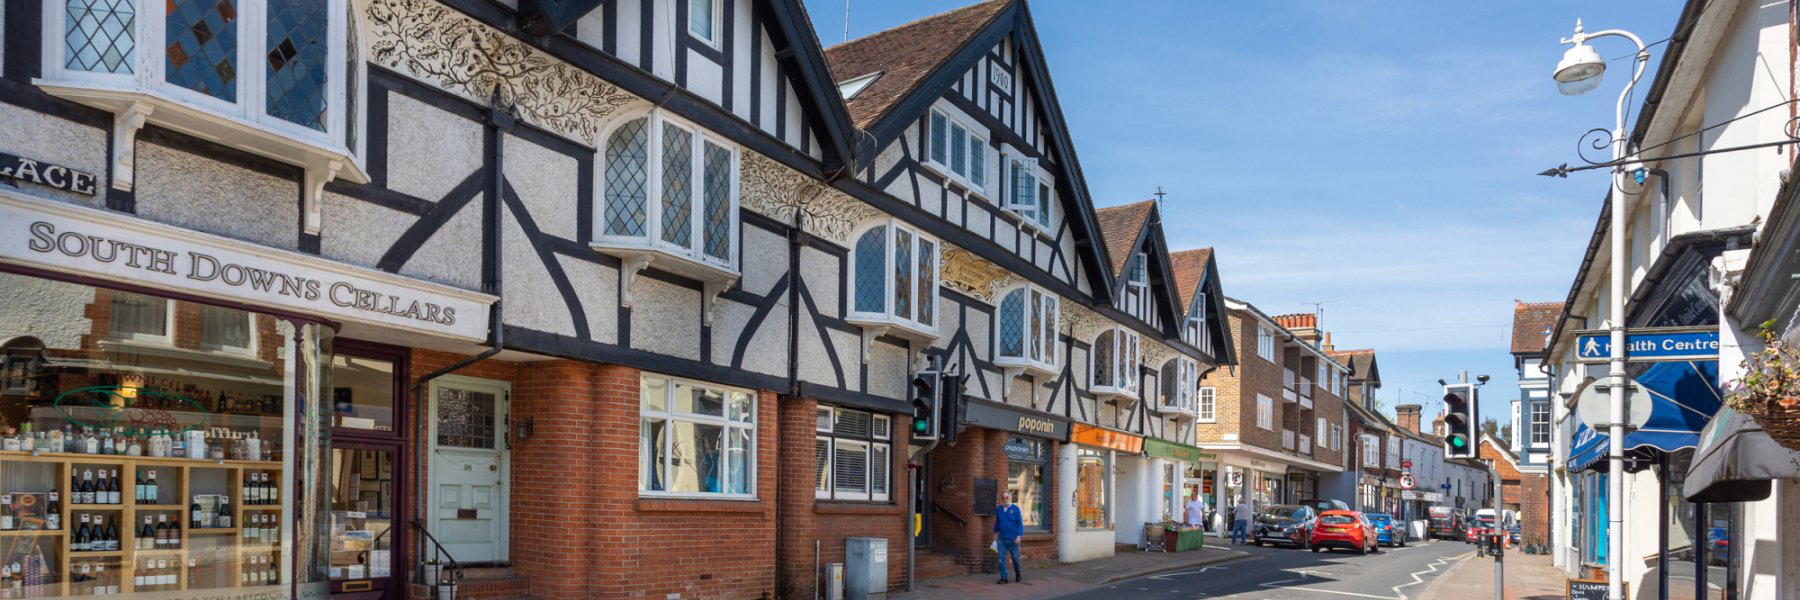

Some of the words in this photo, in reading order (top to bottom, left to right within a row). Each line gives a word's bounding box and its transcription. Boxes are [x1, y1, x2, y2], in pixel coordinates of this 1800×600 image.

[28, 221, 178, 275] SOUTH
[187, 251, 321, 300] DOWNS
[329, 281, 456, 326] CELLARS
[1605, 339, 1657, 352] Halth
[1662, 338, 1719, 351] Centre
[1018, 416, 1054, 433] poponin
[1005, 444, 1029, 454] poponin
